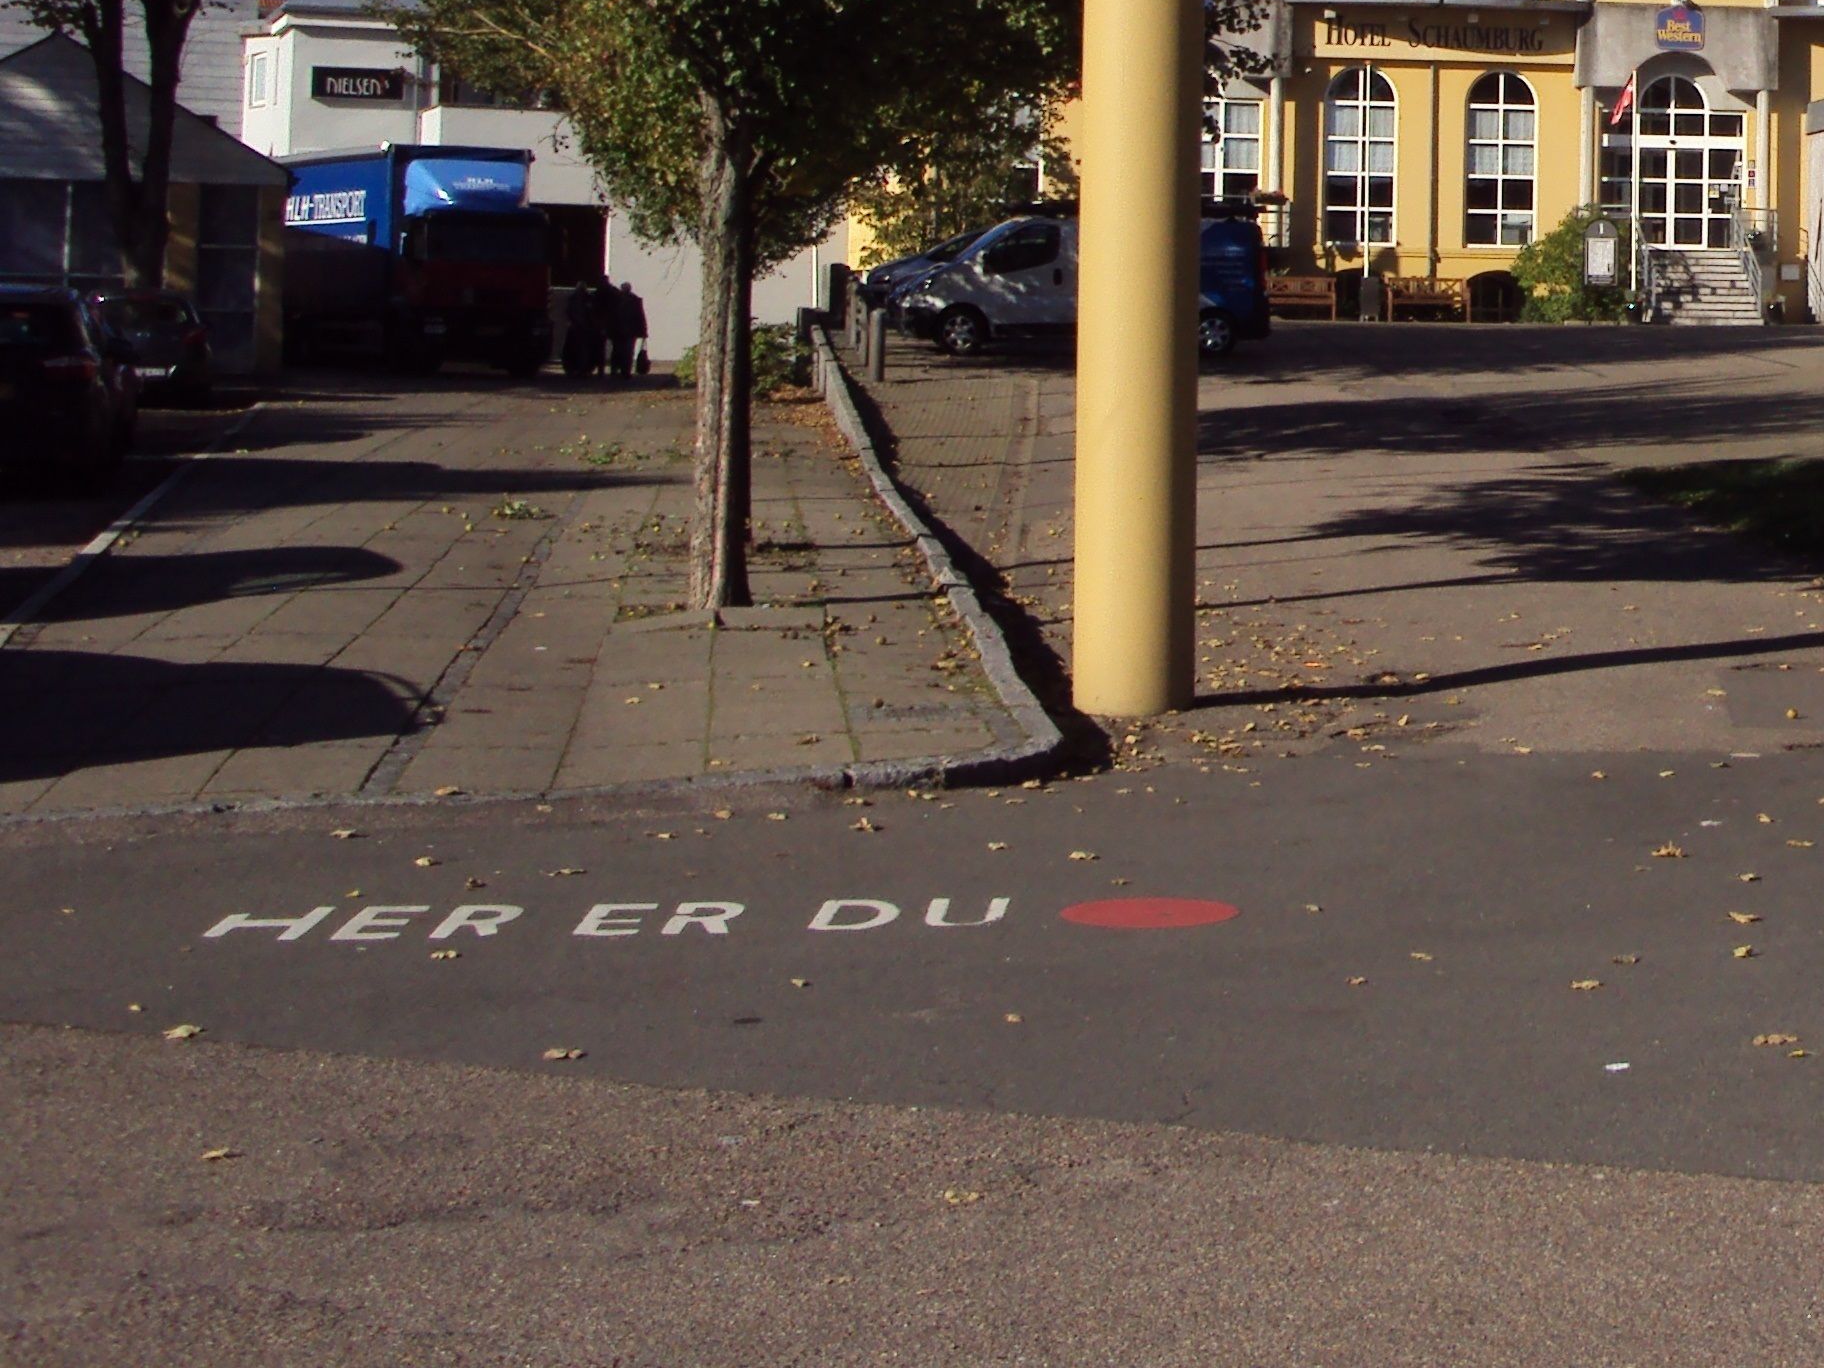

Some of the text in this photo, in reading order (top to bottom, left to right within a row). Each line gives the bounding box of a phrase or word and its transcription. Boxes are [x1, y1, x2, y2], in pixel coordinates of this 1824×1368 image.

[1667, 20, 1690, 31] Best
[1657, 30, 1701, 42] Western
[202, 897, 1011, 941] HER ER DU
